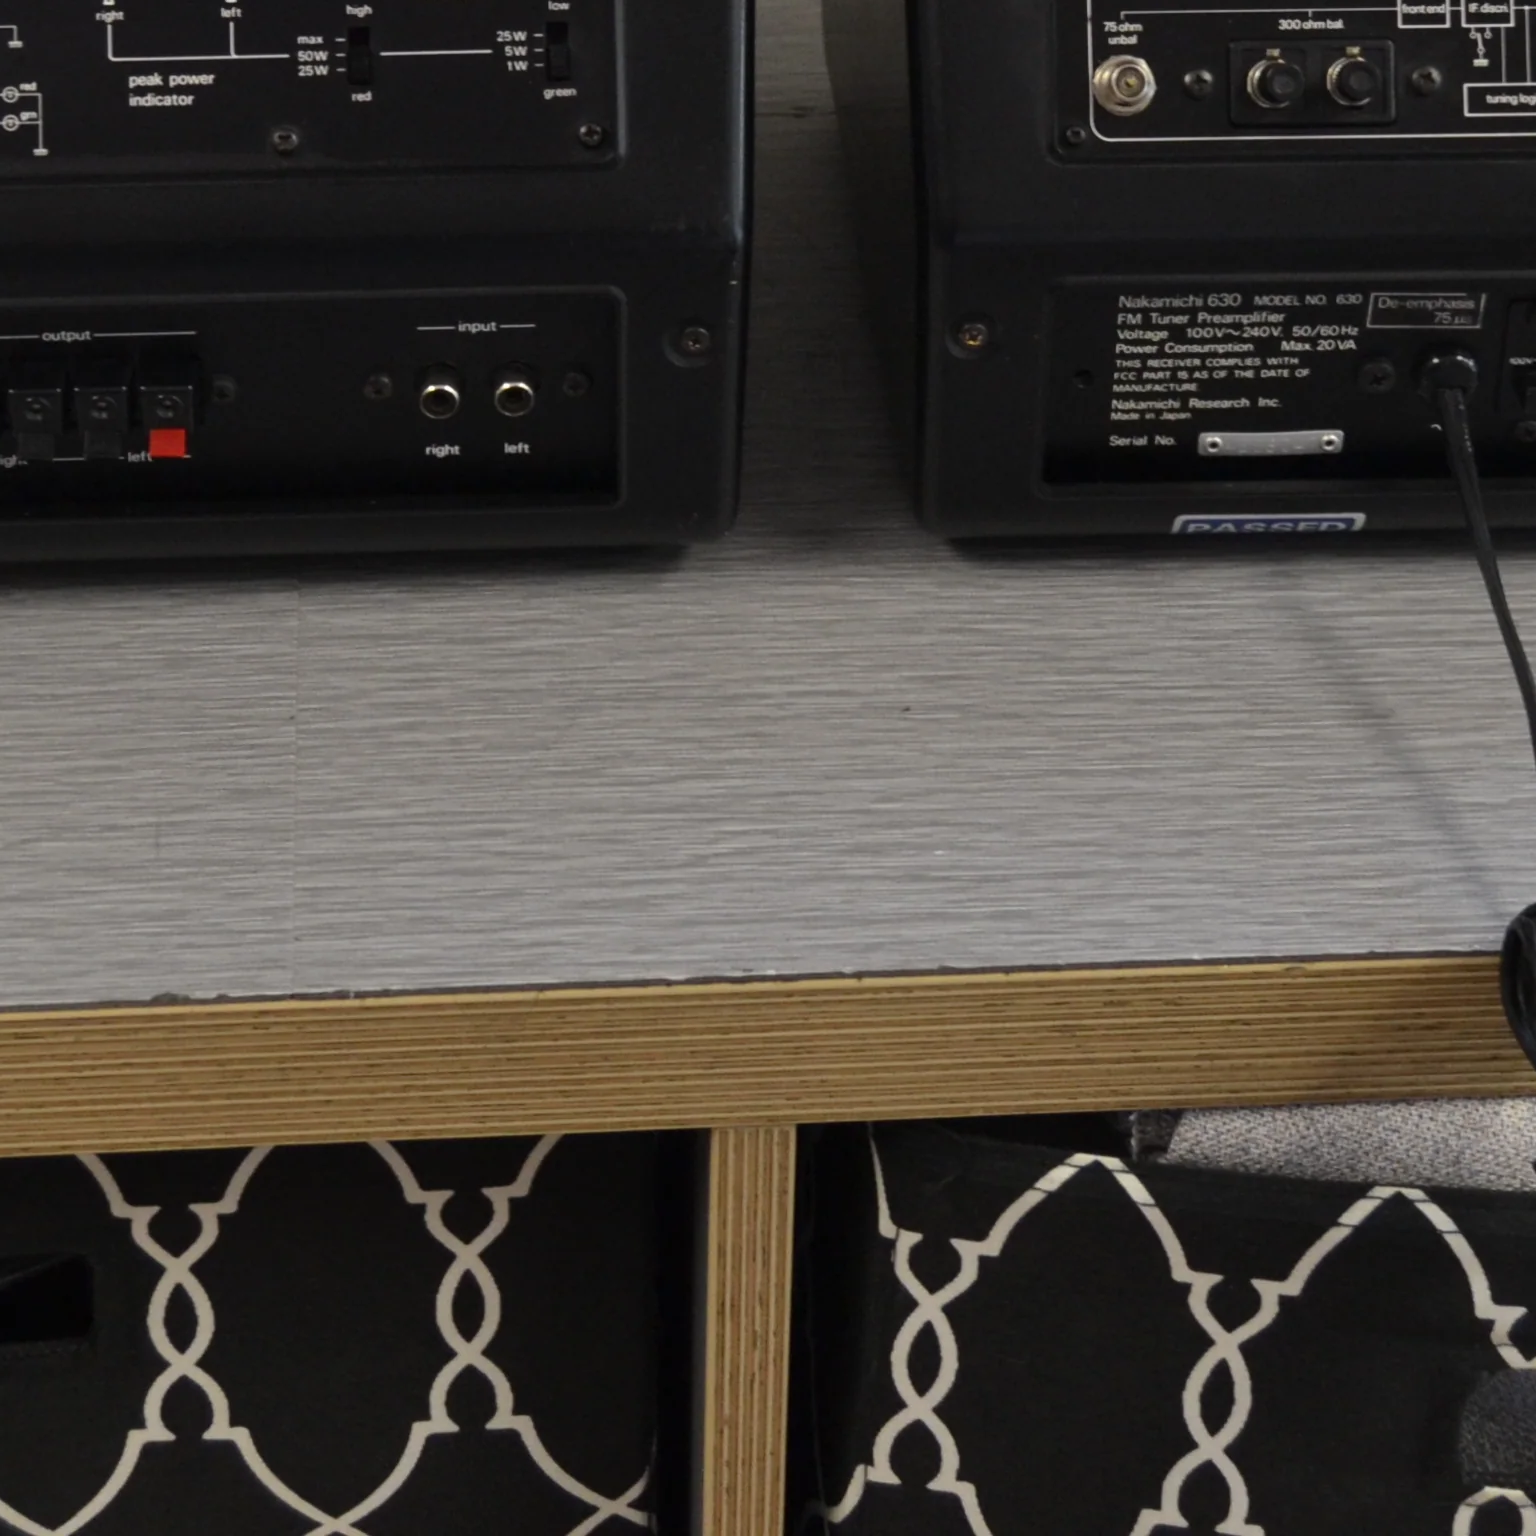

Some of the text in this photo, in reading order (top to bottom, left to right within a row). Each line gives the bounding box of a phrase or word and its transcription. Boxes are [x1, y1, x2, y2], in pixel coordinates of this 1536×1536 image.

[220, 6, 243, 19] left
[346, 5, 374, 19] high
[548, 1, 571, 11] low
[95, 10, 125, 24] right
[1103, 21, 1143, 33] 75 ohm
[297, 35, 324, 45] max
[496, 30, 528, 42] 25W
[1108, 34, 1138, 45] unbal
[297, 50, 330, 62] 50W
[504, 45, 528, 57] 5W
[297, 64, 330, 77] 25W
[507, 60, 530, 72] 1W
[128, 72, 216, 88] peak power
[128, 93, 196, 107] indicator
[352, 90, 373, 102] red
[544, 87, 578, 100] green
[1486, 93, 1518, 106] tuning
[1118, 293, 1203, 309] Nakamichi
[1207, 293, 1242, 308] 630
[1253, 295, 1300, 306] MODEL
[1336, 293, 1363, 305] 630
[1117, 311, 1286, 325] FM Tuner Preamplifier
[458, 320, 498, 334] input
[42, 330, 92, 345] output
[1117, 329, 1169, 341] Voltage
[1115, 343, 1159, 355] Power
[1164, 341, 1255, 354] Consumption
[1116, 356, 1300, 368] THIS RECEIVER COMPLIES WITH
[1113, 367, 1312, 380] FCC PART 15 AS OF THE DATE OF
[1111, 396, 1283, 410] Nakamichi Research Inc.
[1110, 411, 1192, 422] Made in Japan
[1108, 434, 1178, 446] Serial No.
[425, 444, 461, 459] right
[504, 442, 531, 455] left
[1186, 520, 1347, 533] PASSED
